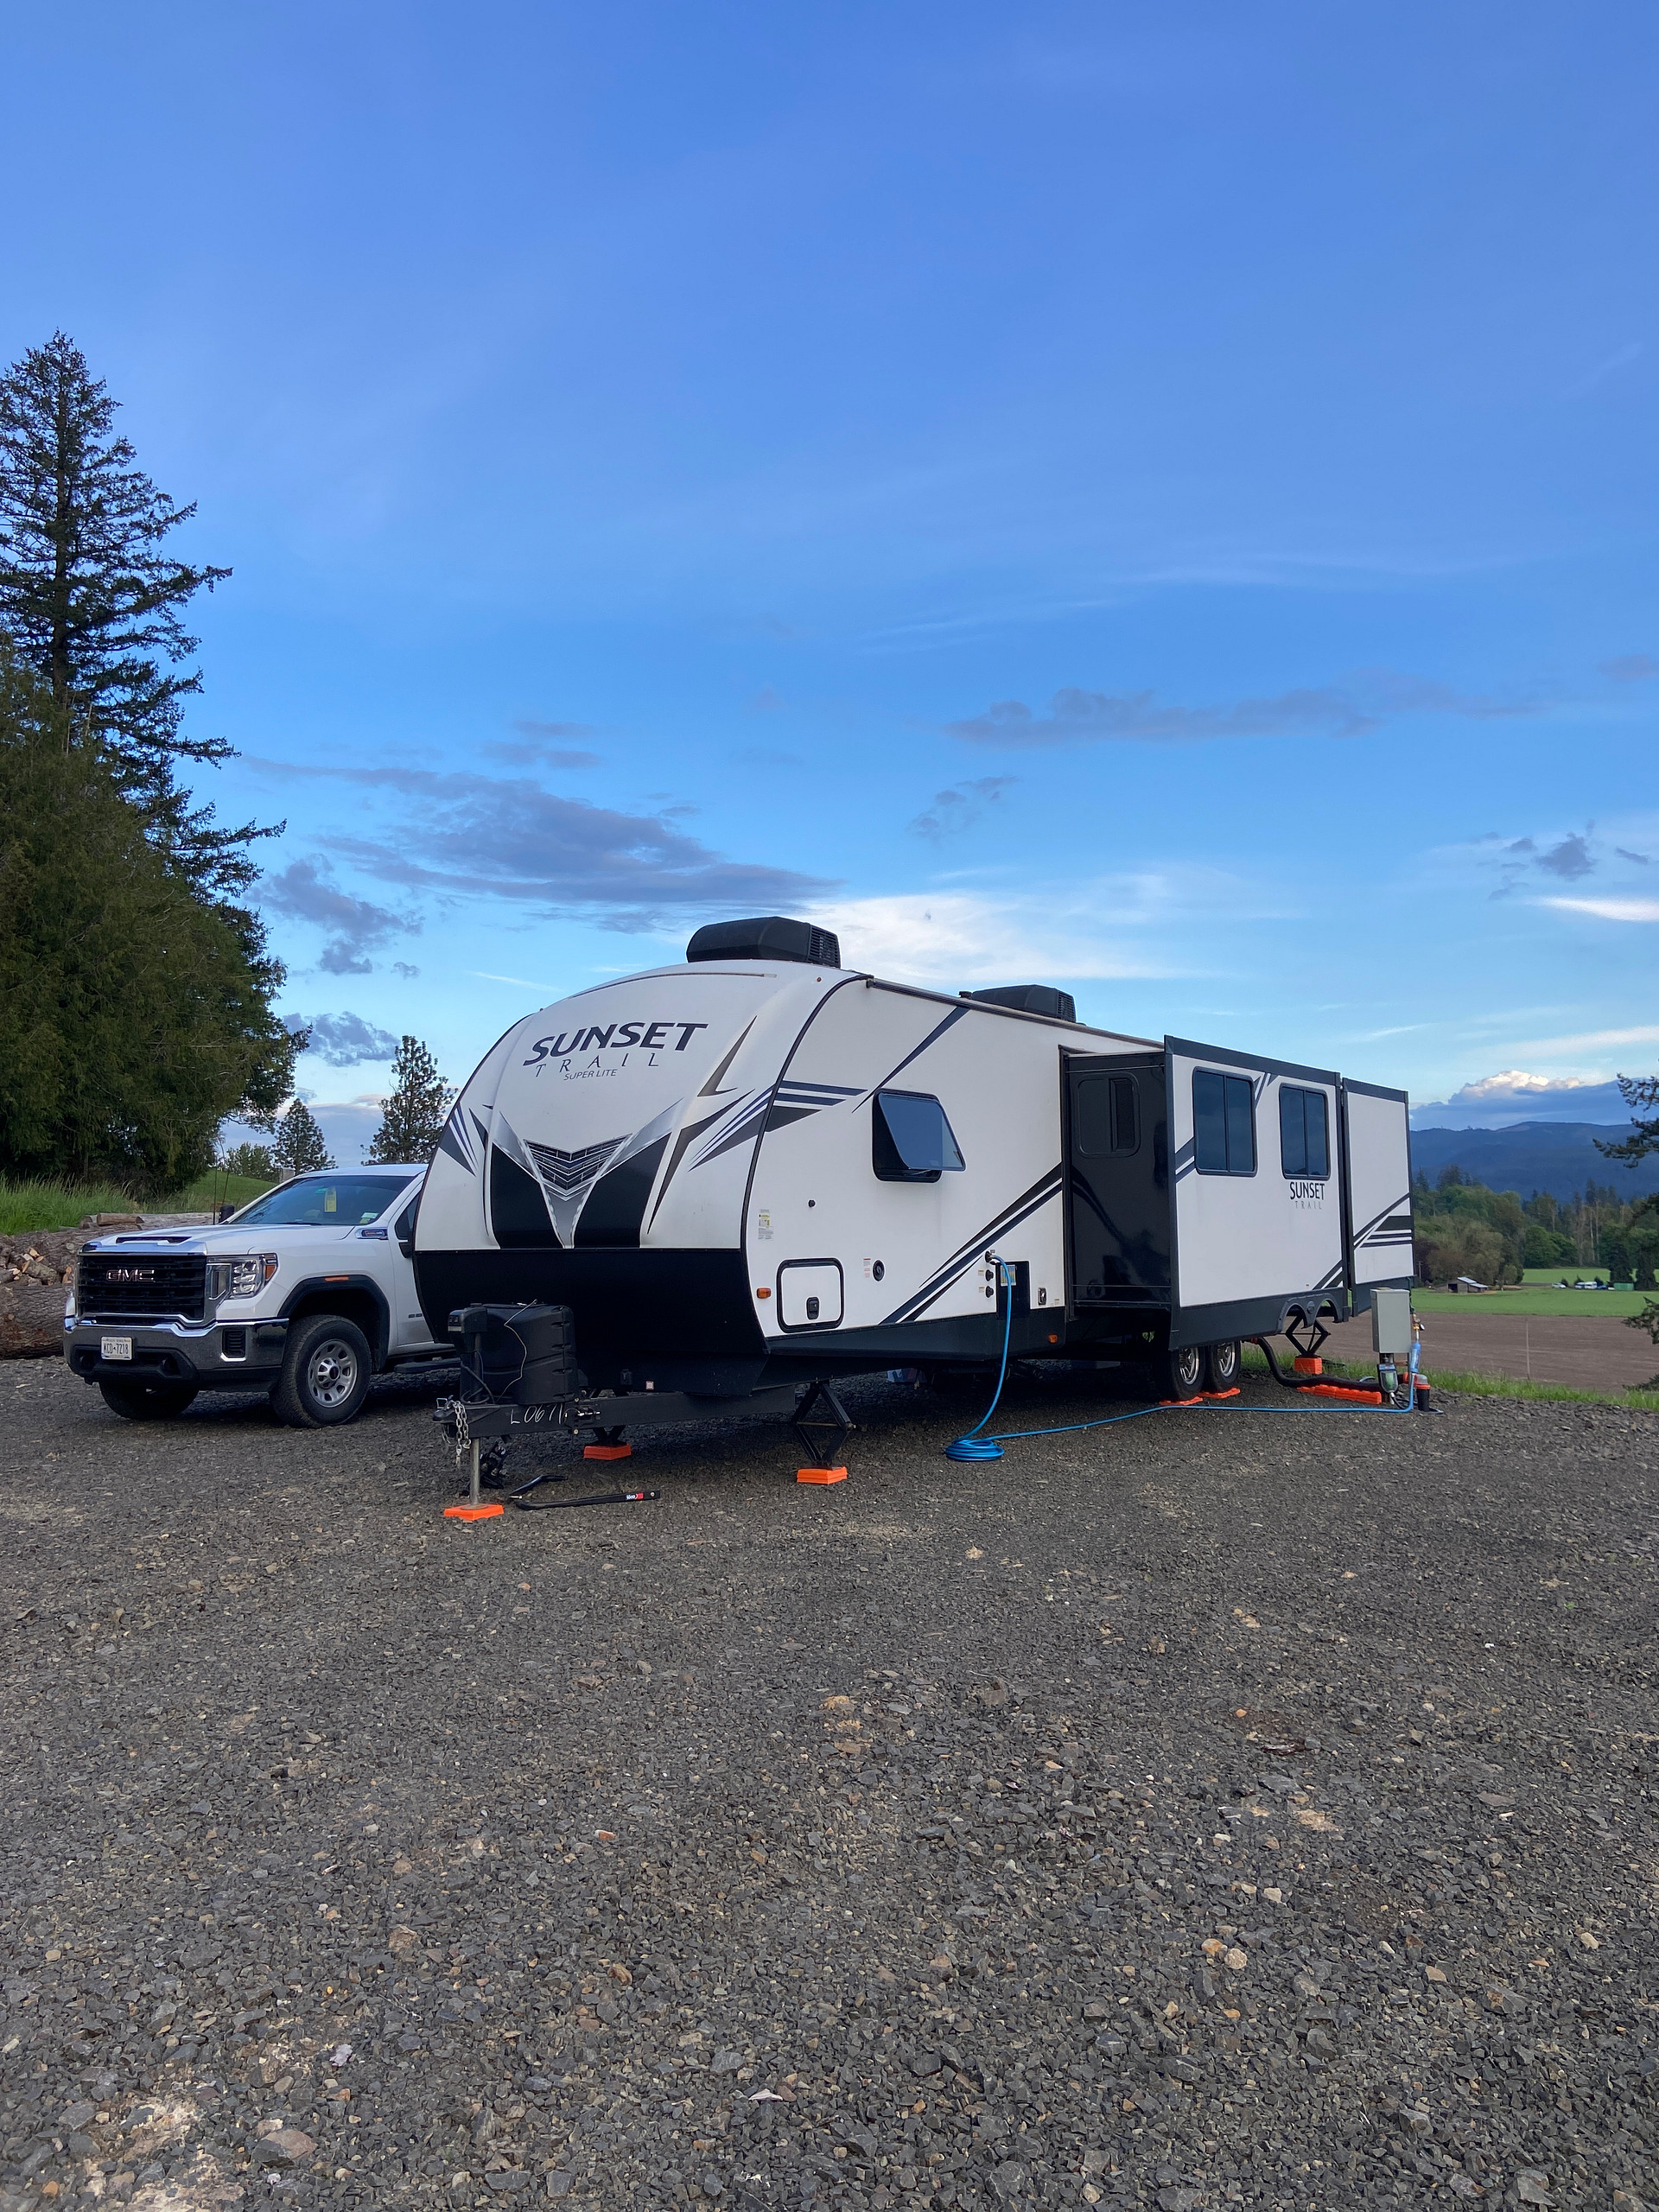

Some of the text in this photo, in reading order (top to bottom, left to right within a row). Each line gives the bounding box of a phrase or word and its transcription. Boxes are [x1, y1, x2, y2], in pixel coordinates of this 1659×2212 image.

[523, 1022, 709, 1065] SUNSET
[536, 1052, 658, 1077] TRAIL
[563, 1069, 618, 1080] SUPER LITE
[1290, 1182, 1325, 1200] SUNSET
[1295, 1200, 1322, 1209] TRAIL
[106, 1269, 155, 1282] GMC
